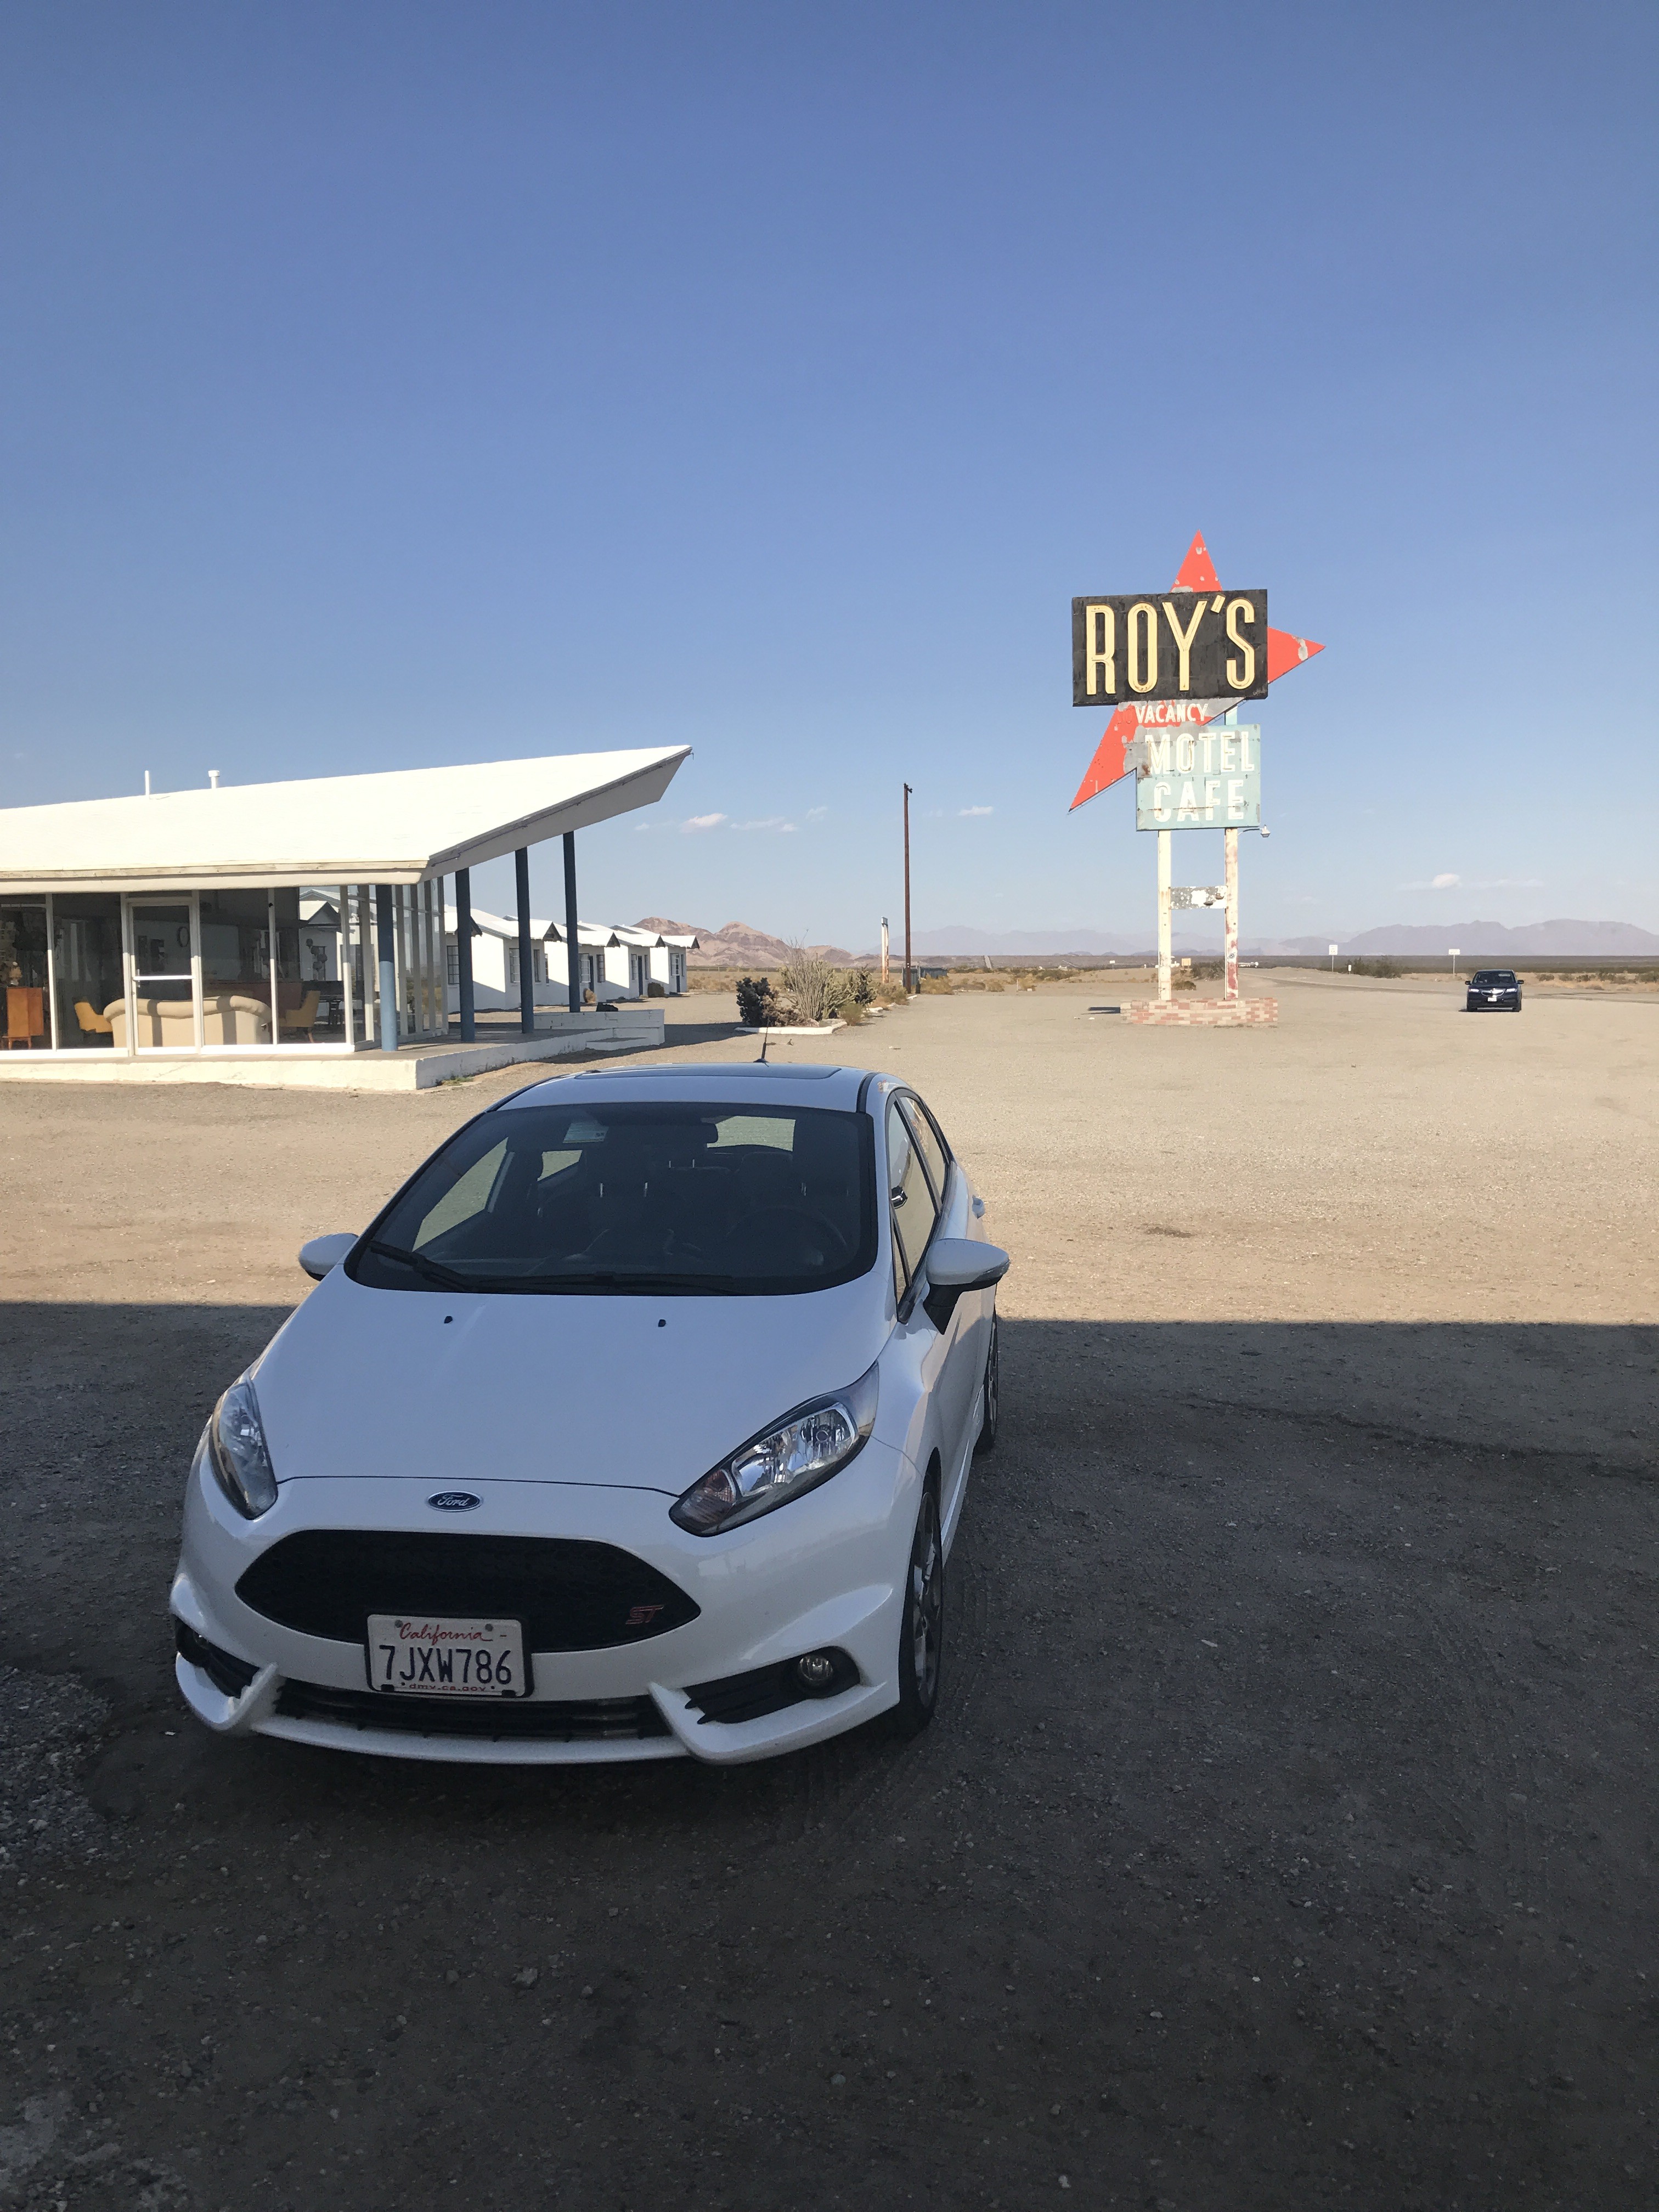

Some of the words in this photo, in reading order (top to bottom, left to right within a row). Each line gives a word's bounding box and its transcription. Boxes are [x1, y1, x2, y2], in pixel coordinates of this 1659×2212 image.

[1086, 595, 1255, 695] ROY'S
[1135, 703, 1208, 724] VACANCY
[1145, 731, 1255, 775] MOTEL
[1154, 780, 1244, 822] CAFE
[437, 1494, 470, 1506] Ford
[625, 1605, 664, 1624] ST
[399, 1623, 493, 1645] California
[379, 1645, 511, 1684] 7JXW786
[409, 1683, 486, 1691] dmv.ca.gov
